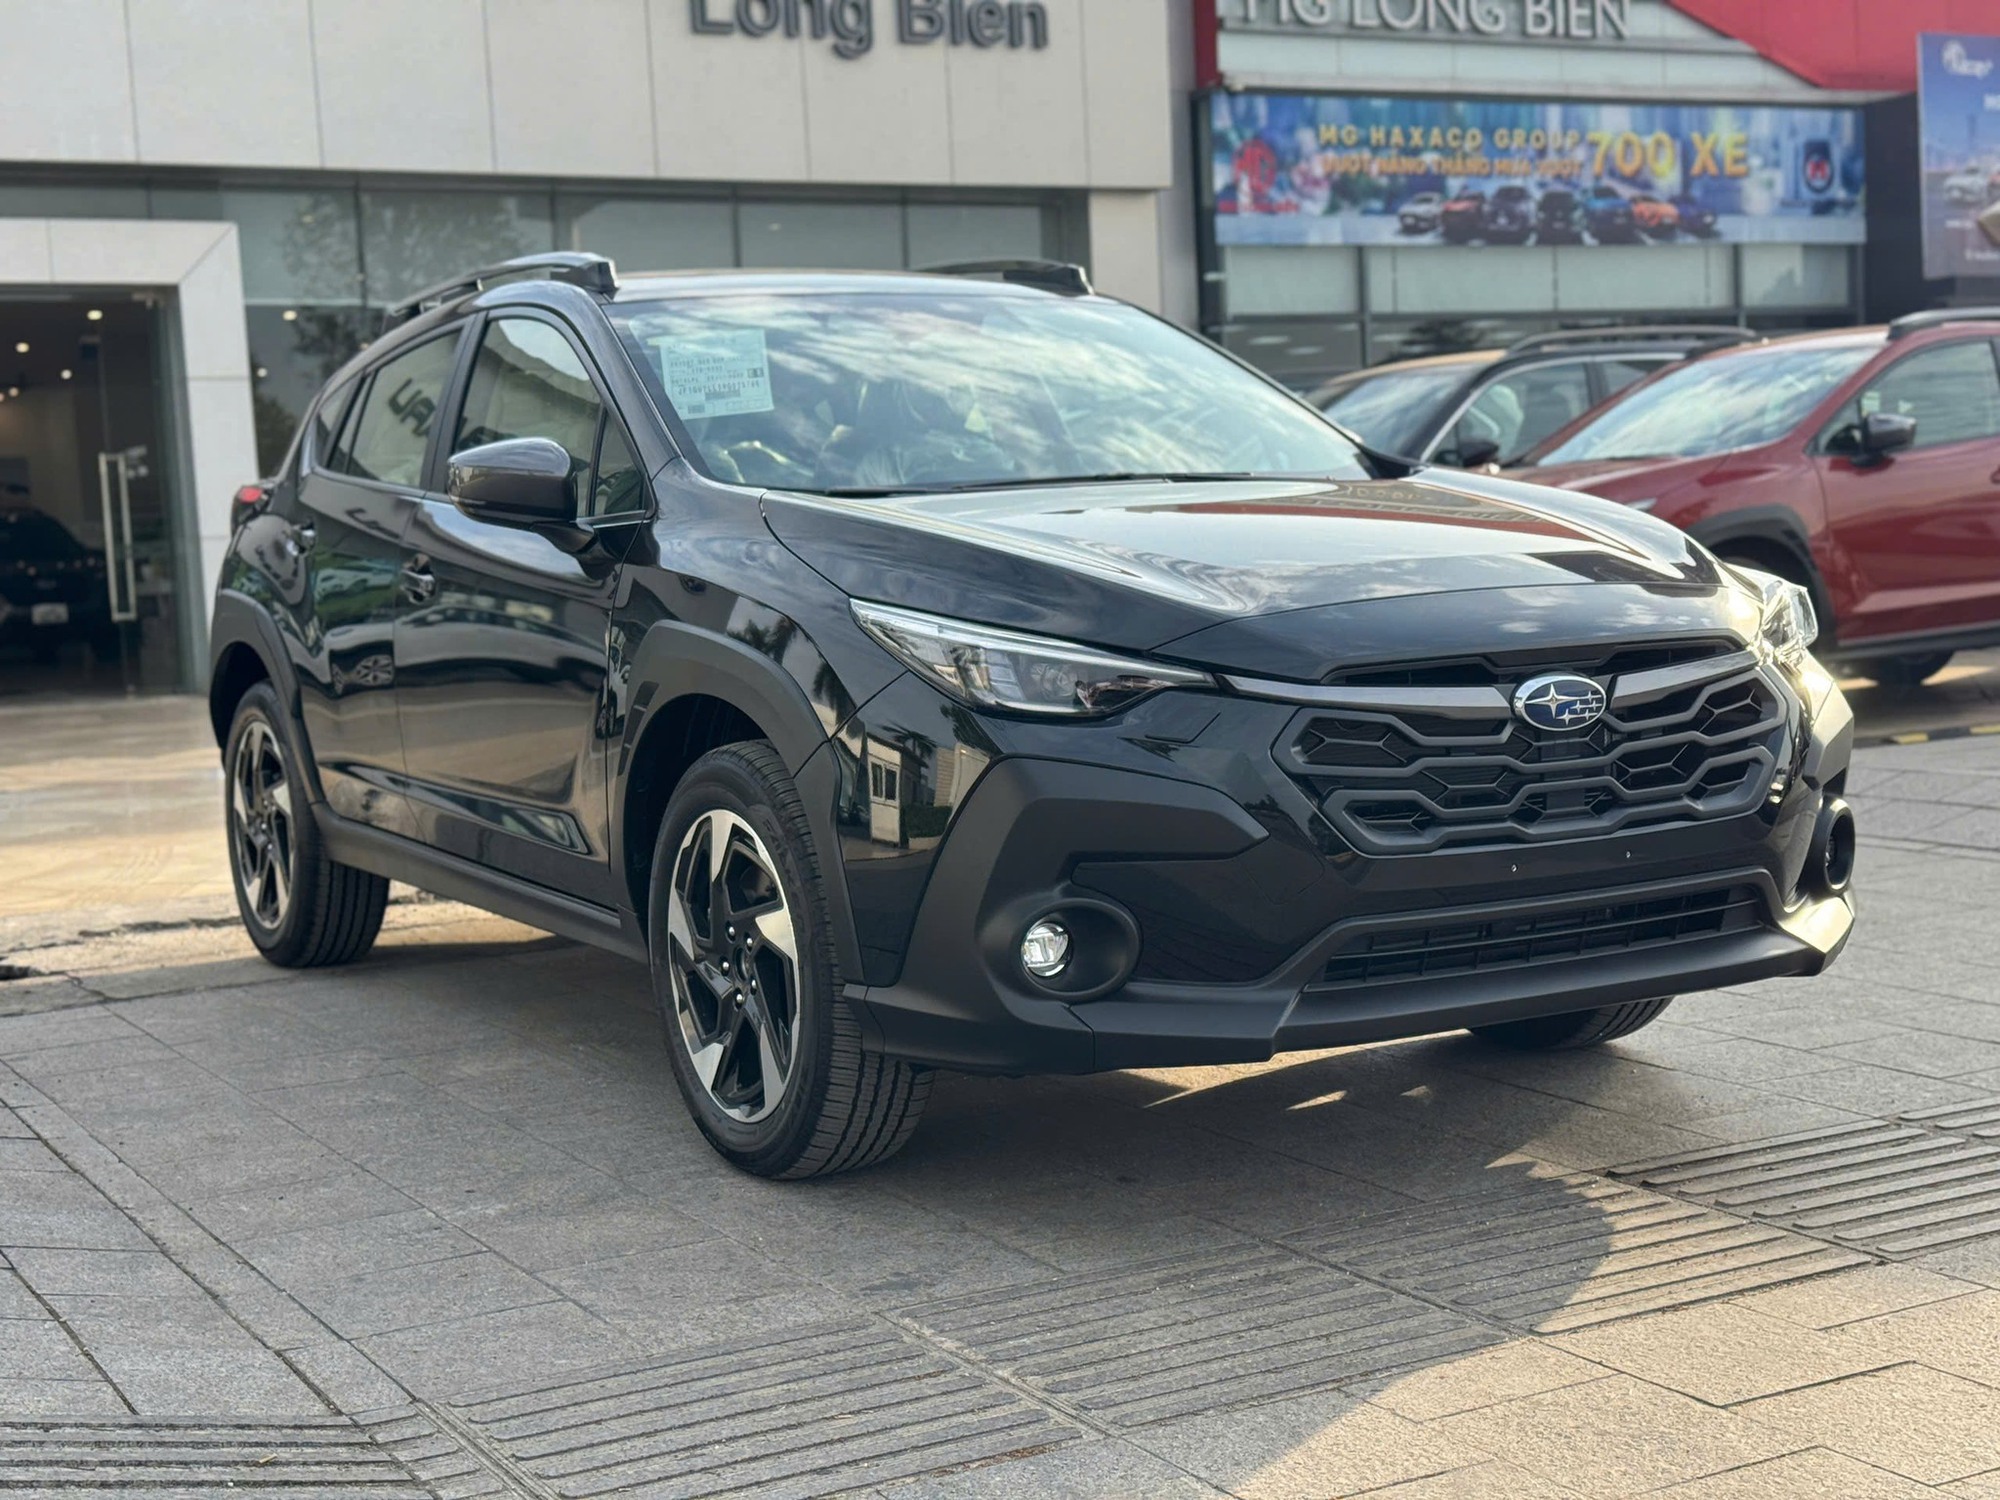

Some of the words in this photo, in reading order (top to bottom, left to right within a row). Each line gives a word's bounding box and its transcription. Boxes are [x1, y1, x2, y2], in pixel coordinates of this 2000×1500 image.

[690, 0, 873, 59] Long
[1353, 0, 1506, 35] LONG
[1318, 124, 1358, 147] MG
[1494, 128, 1581, 149] GROUP
[1587, 131, 1676, 178] 700
[1690, 132, 1750, 177] XE
